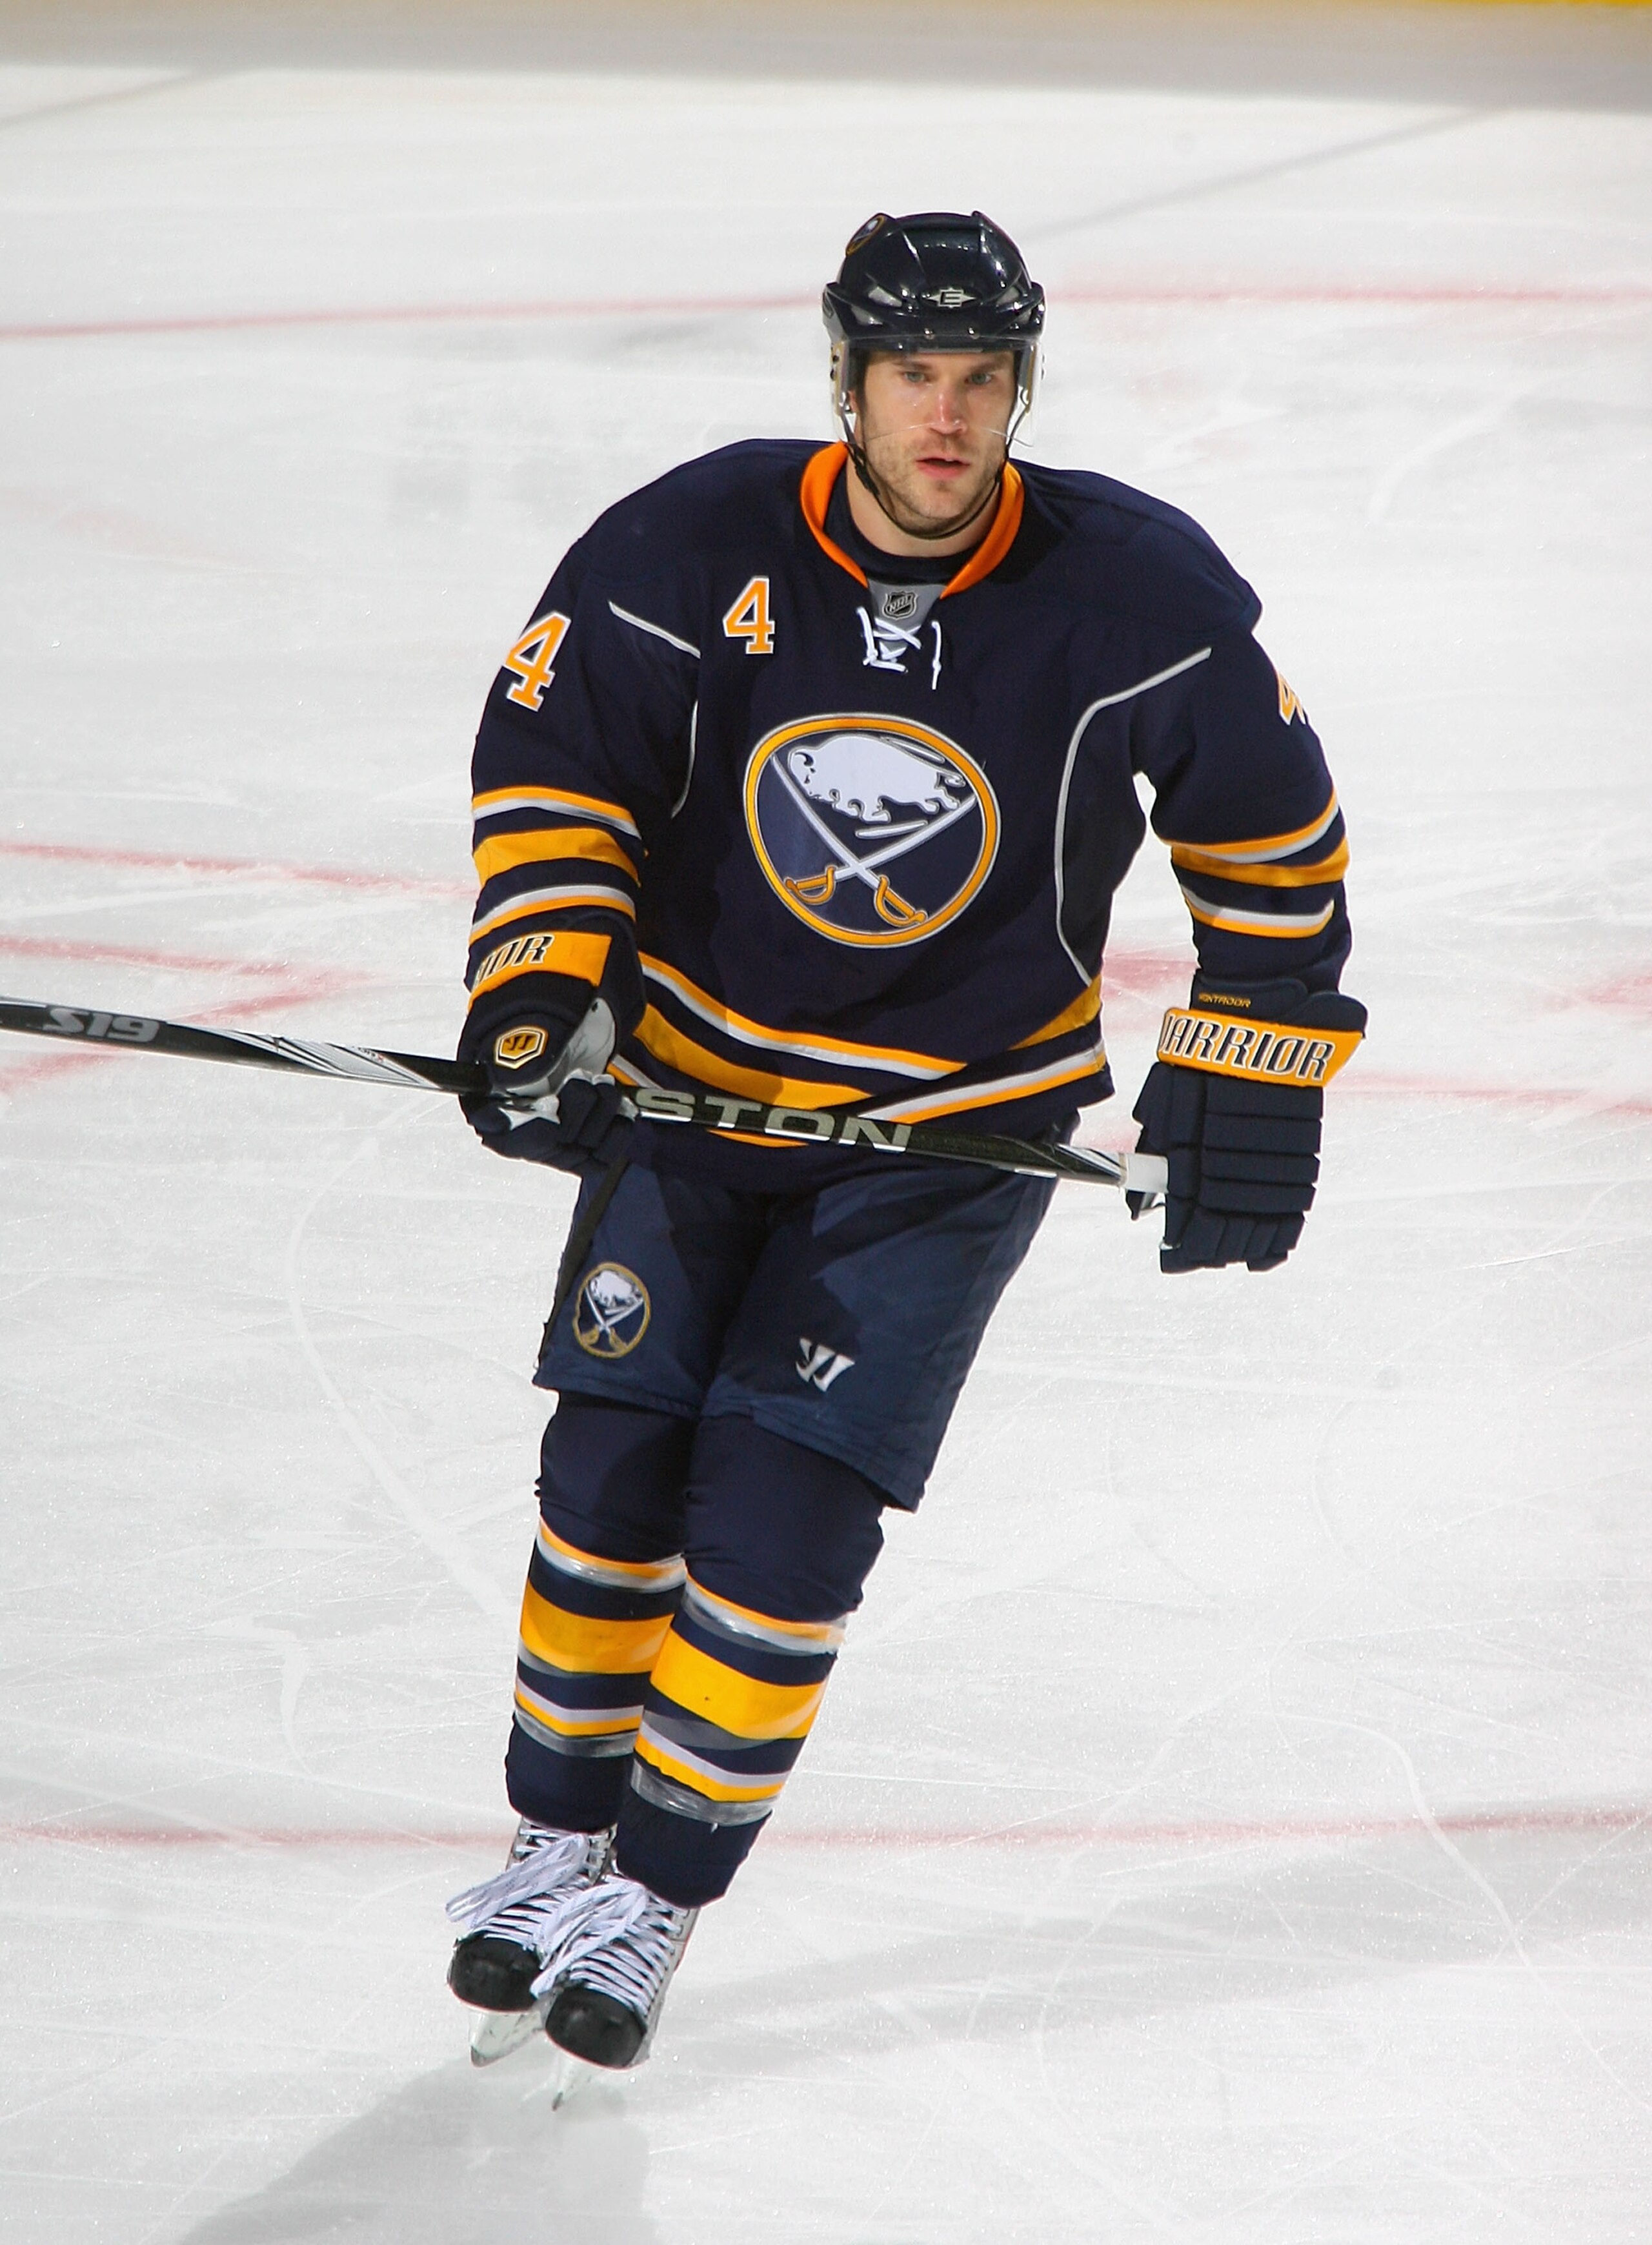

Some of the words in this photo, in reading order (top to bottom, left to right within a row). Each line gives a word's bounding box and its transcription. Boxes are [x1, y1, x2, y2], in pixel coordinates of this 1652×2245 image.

[722, 576, 775, 655] 4
[889, 594, 909, 613] NHL
[501, 611, 572, 712] 4
[473, 933, 554, 988] IOR
[42, 1008, 160, 1042] S19
[1159, 1013, 1336, 1081] ARRIOR
[636, 1088, 913, 1152] STON
